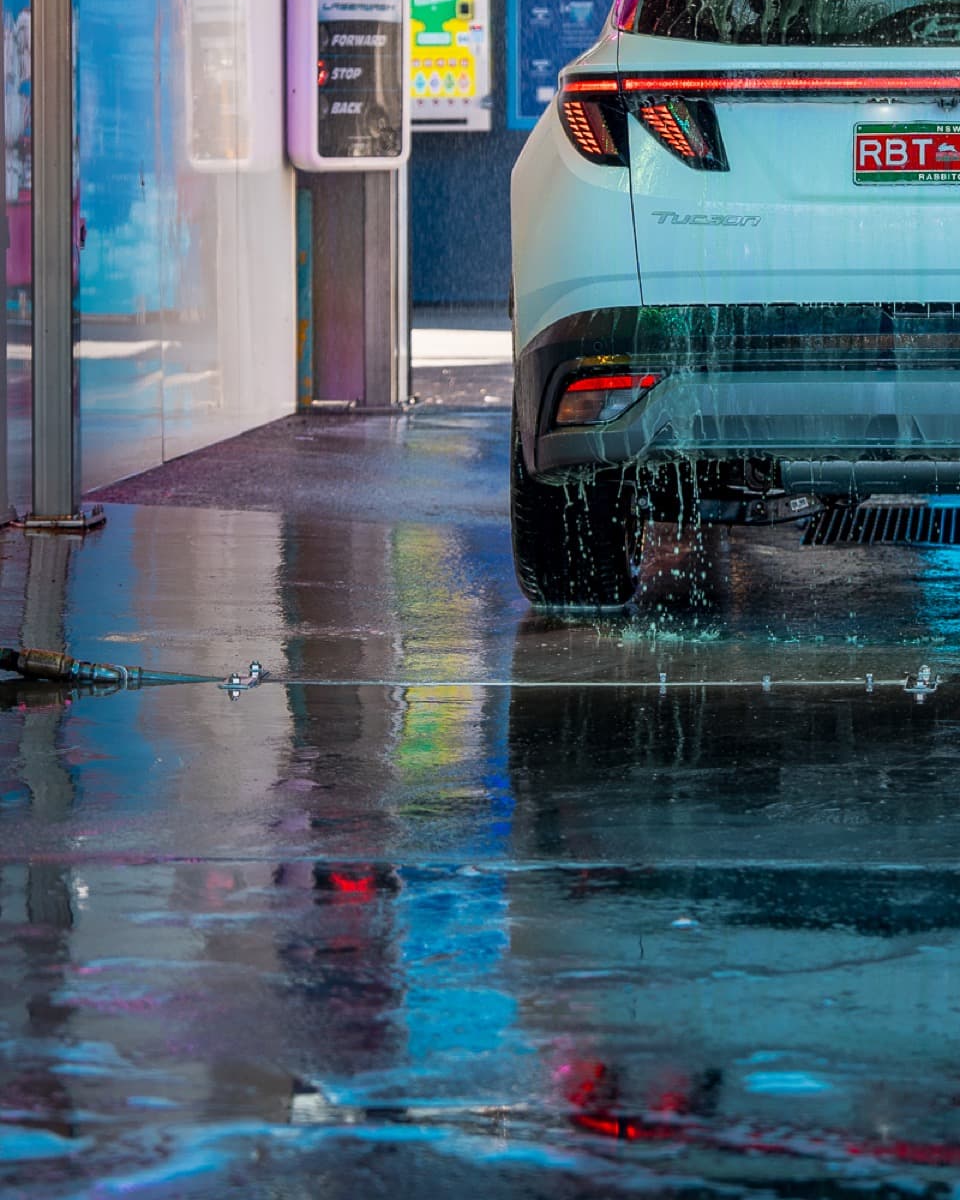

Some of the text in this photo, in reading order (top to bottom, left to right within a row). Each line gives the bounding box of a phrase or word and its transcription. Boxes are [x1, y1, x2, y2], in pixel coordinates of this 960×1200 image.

[331, 34, 387, 47] FORWARD
[331, 67, 363, 80] STOP
[331, 102, 363, 115] BACK
[859, 138, 933, 167] RBT
